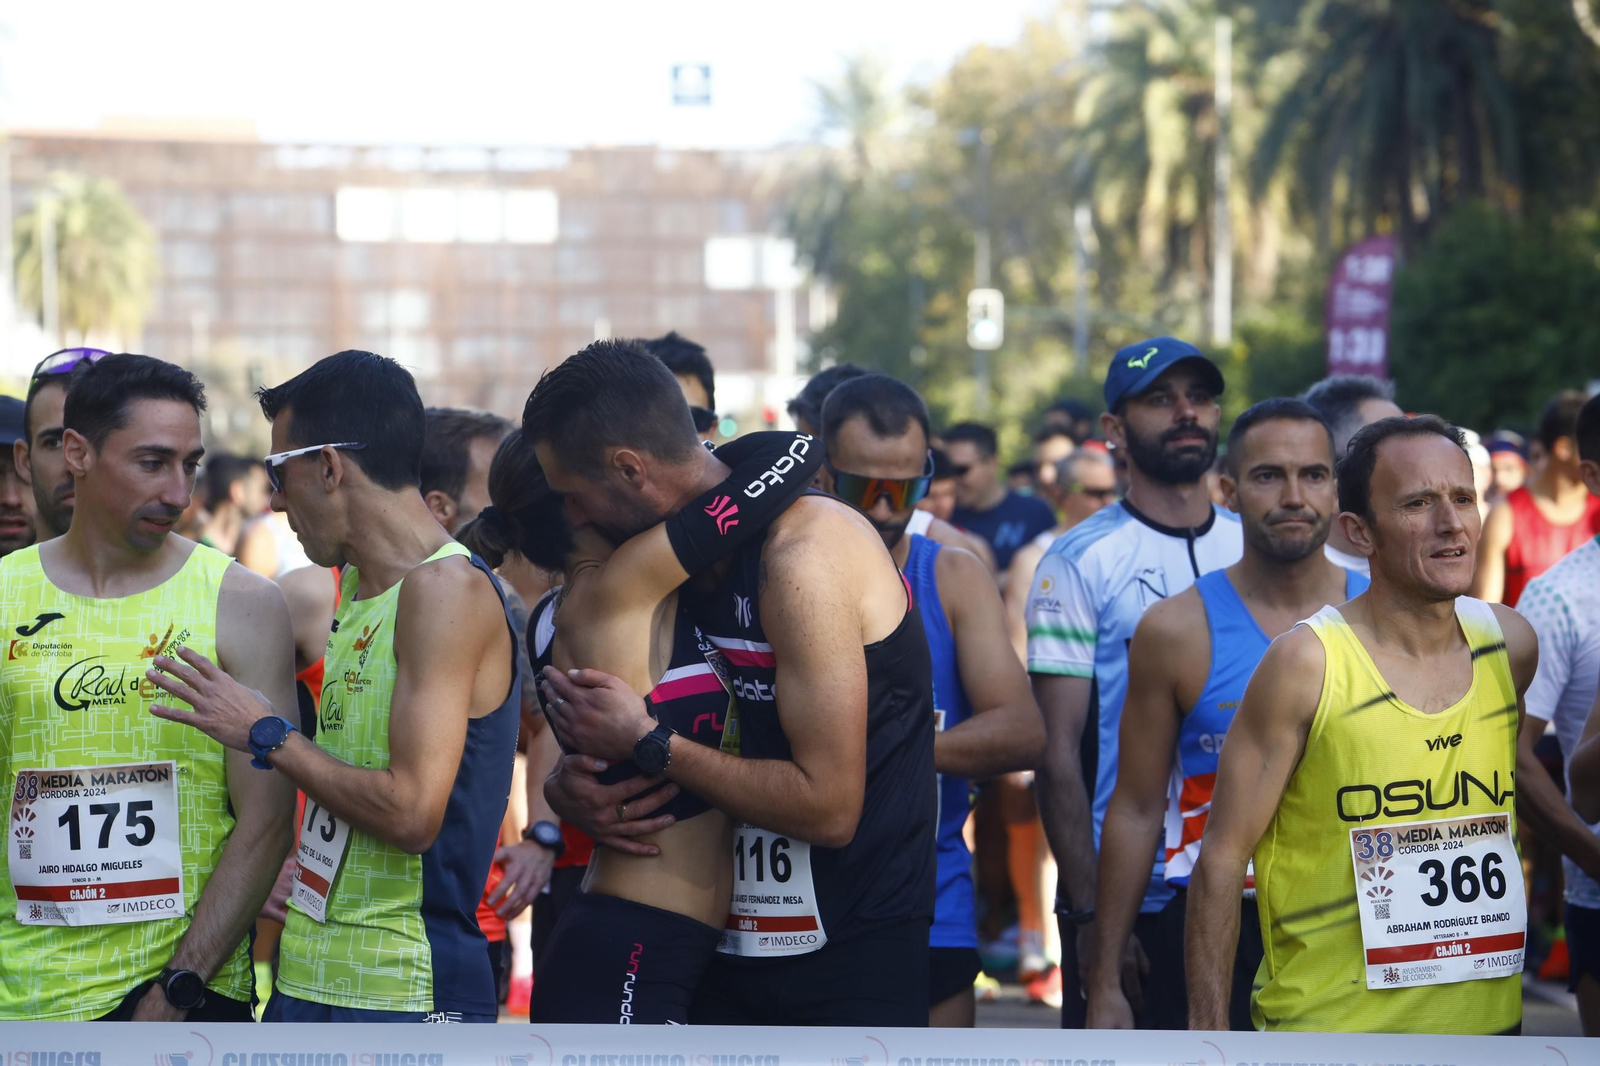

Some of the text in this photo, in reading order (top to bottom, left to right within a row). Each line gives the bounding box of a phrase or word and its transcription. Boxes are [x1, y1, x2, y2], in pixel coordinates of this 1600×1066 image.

[32, 642, 73, 650] Diputación
[92, 697, 126, 706] METAL
[1425, 733, 1463, 751] vive
[15, 765, 169, 800] 38 MEDIA MARATÓN
[41, 787, 107, 799] CÓRDOBA 2024
[58, 800, 156, 851] 175
[1356, 817, 1507, 859] 38 MEDIA MARATÓN
[1398, 840, 1464, 855] CÓRDOBA 2024
[38, 859, 143, 874] JAIRO HIDALGO MIGUELES
[322, 855, 334, 868] ROSA
[735, 835, 792, 883] 116
[1418, 852, 1507, 907] 366
[69, 886, 106, 900] CAJÓN 2
[748, 893, 780, 904] FERNÁNDEZ
[783, 896, 804, 905] MESA
[123, 898, 175, 913] IMDECO
[304, 890, 323, 912] IMDECO
[753, 920, 758, 931] 2
[1386, 912, 1511, 934] ABRAHAM RODRÍGUEZ BRANDO
[771, 934, 817, 946] IMDECO
[1436, 941, 1471, 957] CAJÓN 2
[1488, 953, 1521, 968] IMDECO
[1402, 965, 1442, 975] AYUNTAMIENTO
[1403, 973, 1437, 982] DE CÓRDOBA
